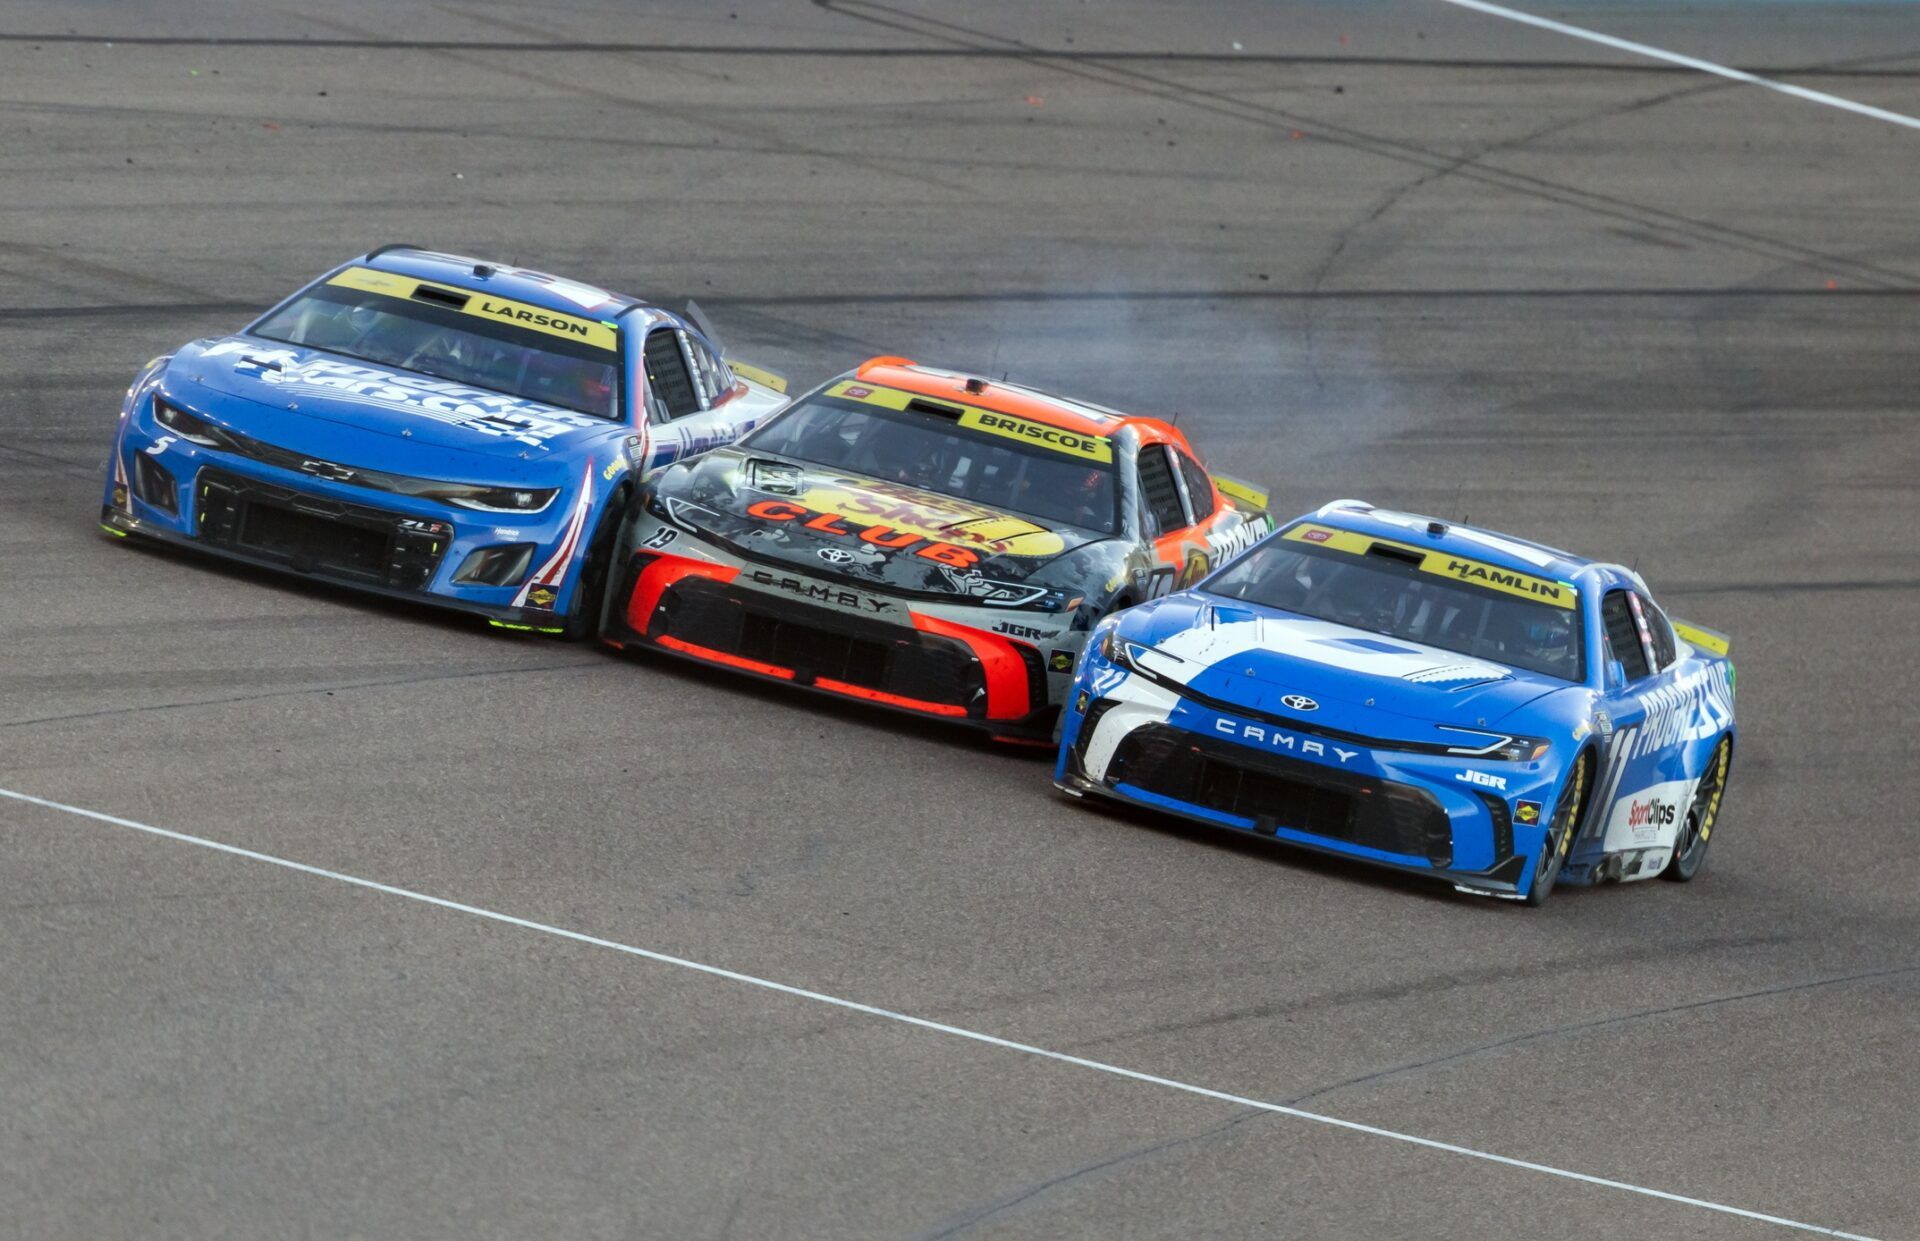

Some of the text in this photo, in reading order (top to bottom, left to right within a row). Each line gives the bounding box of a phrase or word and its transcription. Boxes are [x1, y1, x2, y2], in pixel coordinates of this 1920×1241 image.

[481, 301, 588, 336] LARSON
[145, 436, 178, 455] 5
[978, 414, 1096, 453] BRISCOE
[641, 525, 680, 550] 19
[746, 500, 980, 569] CLUB
[752, 569, 892, 612] CAMRY
[1448, 560, 1560, 599] HAMLIN
[991, 621, 1042, 640] JGR
[1215, 718, 1359, 763] CAMRY
[1455, 769, 1508, 790] JGR
[1582, 727, 1637, 838] 11
